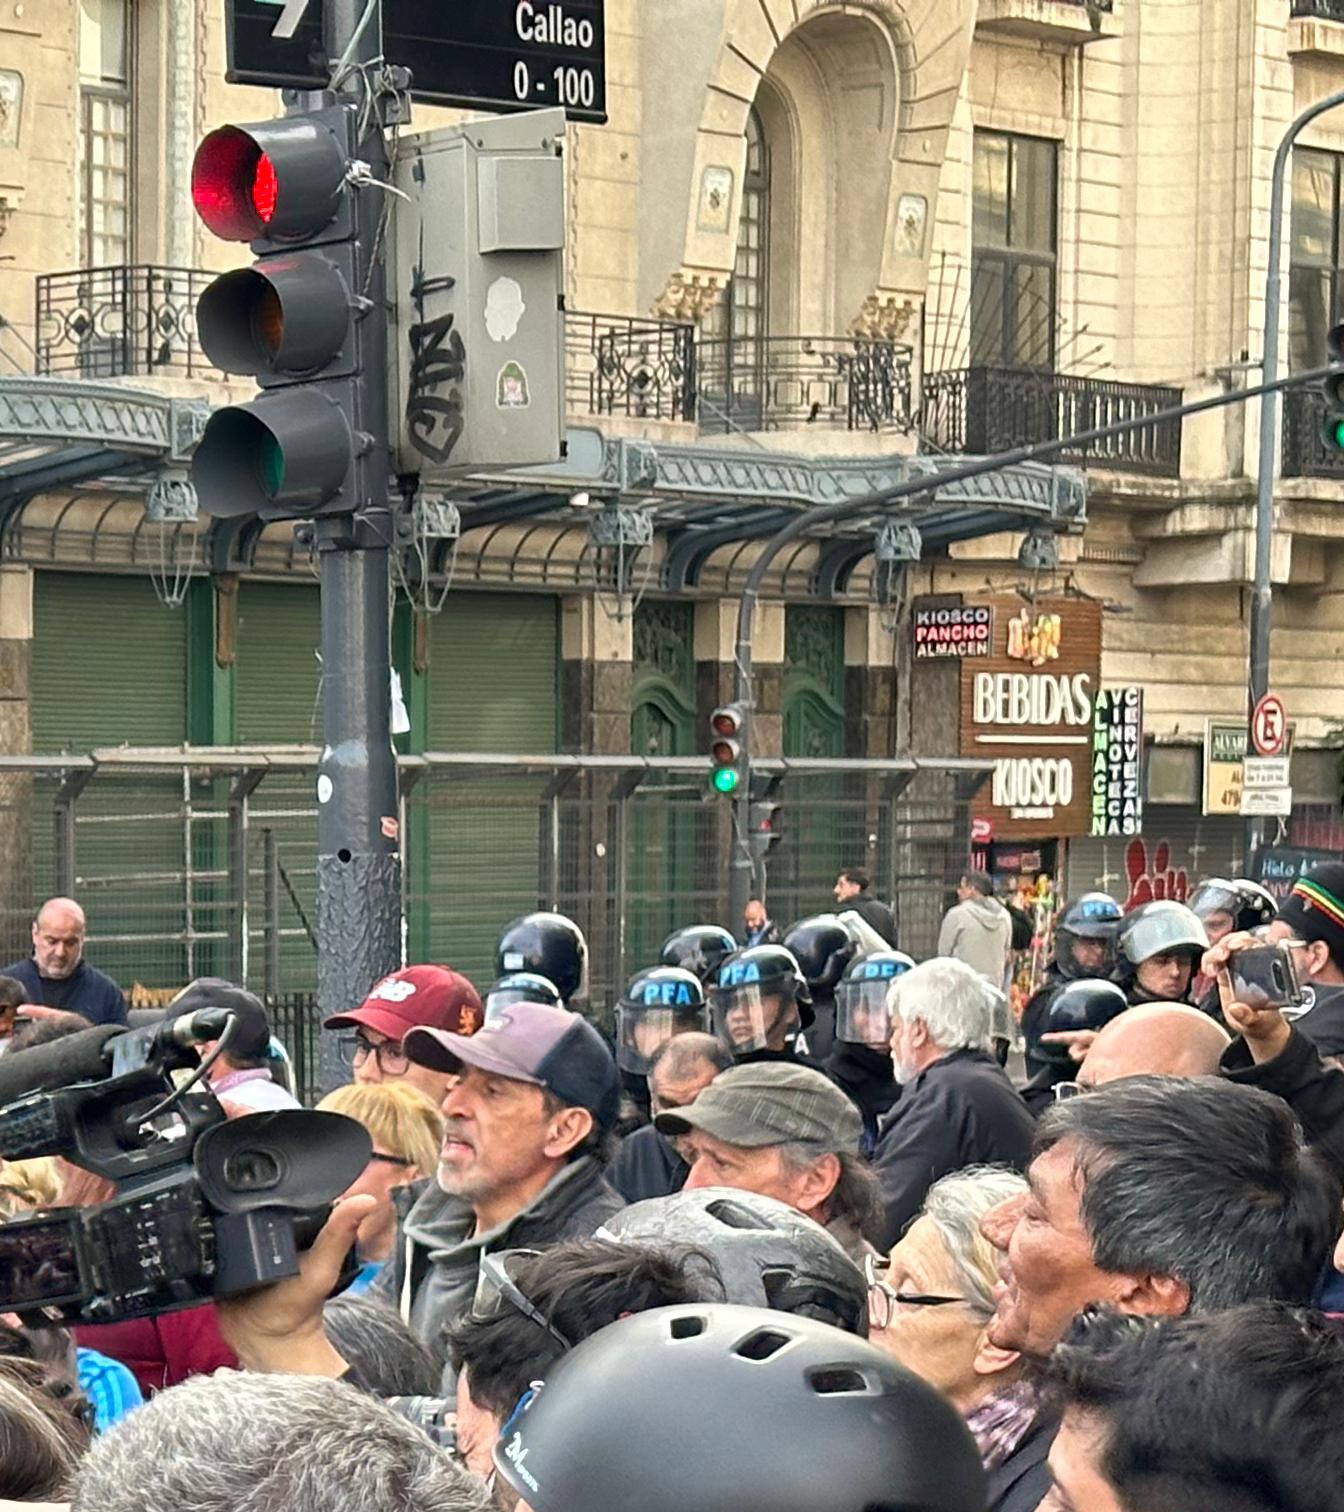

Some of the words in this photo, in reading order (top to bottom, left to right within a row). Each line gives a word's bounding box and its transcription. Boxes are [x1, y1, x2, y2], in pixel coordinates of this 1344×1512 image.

[515, 1, 594, 48] Callao
[514, 61, 528, 99] 0
[553, 65, 594, 107] 100
[916, 624, 988, 641] PANCHO
[917, 608, 988, 625] KIOSCO
[917, 641, 987, 657] ALMACEN
[973, 672, 1091, 725] BEBIDAS
[992, 758, 1073, 806] KIOSCO
[1092, 689, 1108, 836] ALMACEN
[1107, 689, 1123, 835] VINOTECA
[1123, 687, 1138, 835] CERVEZAS
[643, 982, 691, 1006] PFA
